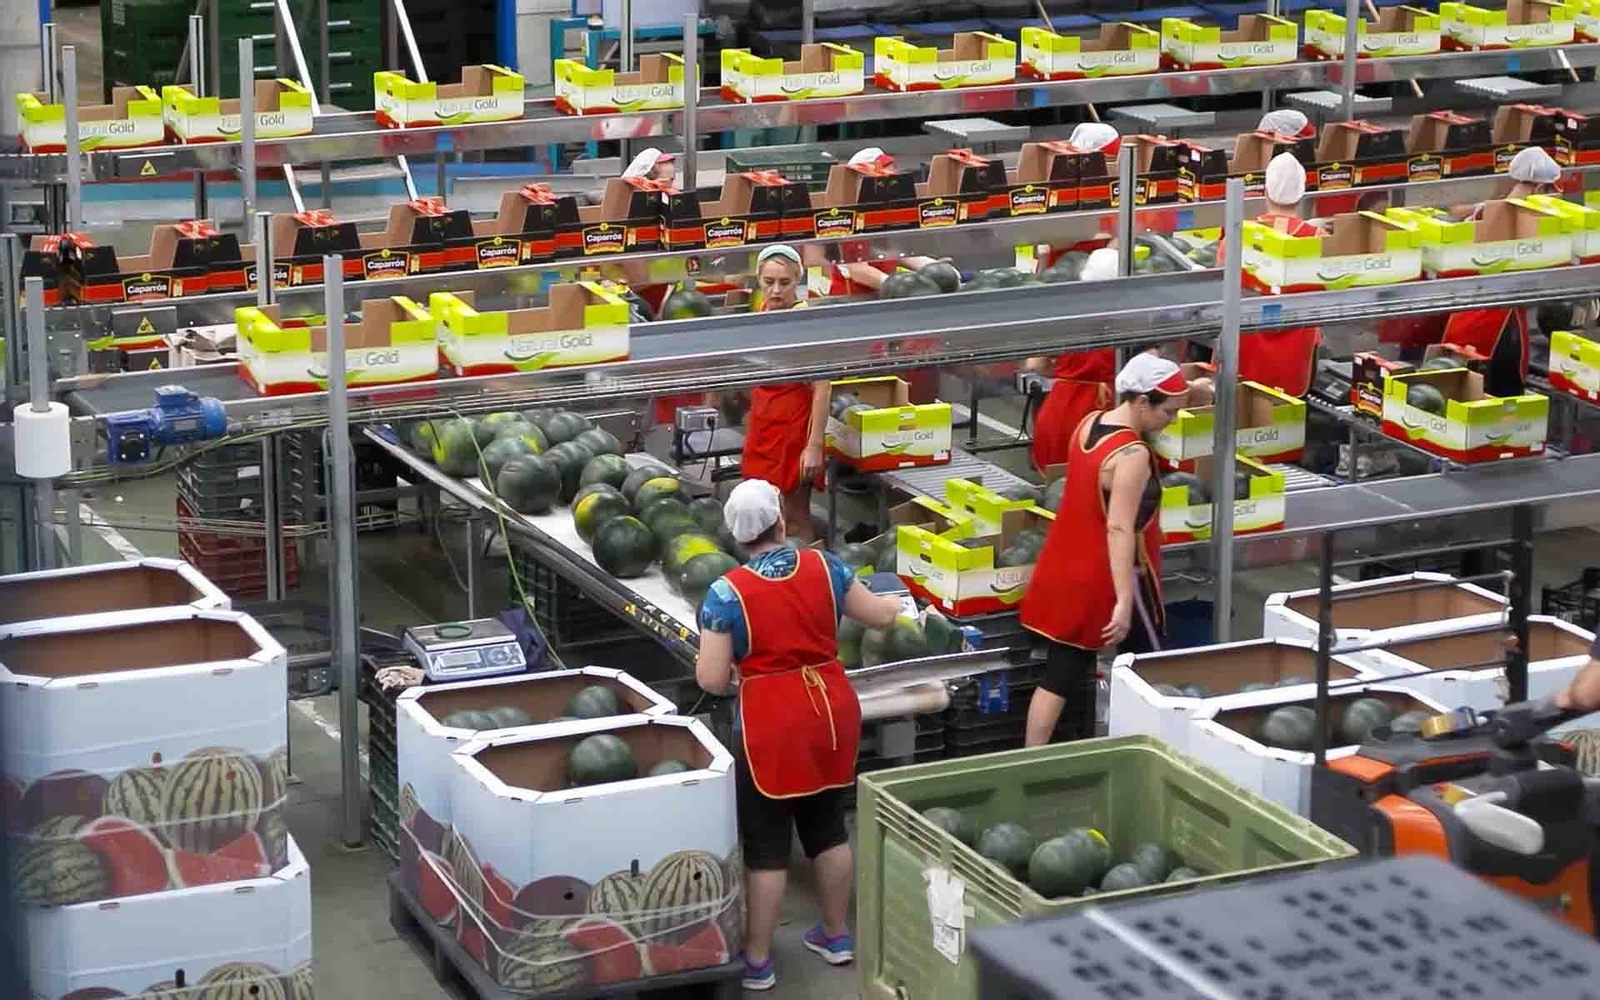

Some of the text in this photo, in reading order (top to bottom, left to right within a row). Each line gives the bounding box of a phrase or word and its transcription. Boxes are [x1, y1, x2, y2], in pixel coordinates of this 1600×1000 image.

[1253, 44, 1274, 55] Gold
[1113, 52, 1136, 64] Gold
[970, 62, 992, 74] Gold
[818, 73, 840, 85] Gold
[651, 86, 674, 97] Gold
[474, 98, 498, 110] Gold
[259, 113, 285, 126] Gold
[108, 121, 135, 134] Gold
[586, 232, 623, 244] Caparrós
[479, 246, 517, 258] Caparrós
[1518, 241, 1543, 255] Gold
[367, 259, 406, 271] Caparrós
[1364, 257, 1392, 270] Gold
[127, 282, 167, 295] Caparrós
[560, 333, 593, 349] Gold
[365, 350, 399, 367] Gold
[1430, 417, 1447, 434] Gold
[914, 430, 934, 441] Gold
[1254, 429, 1279, 443] Gold
